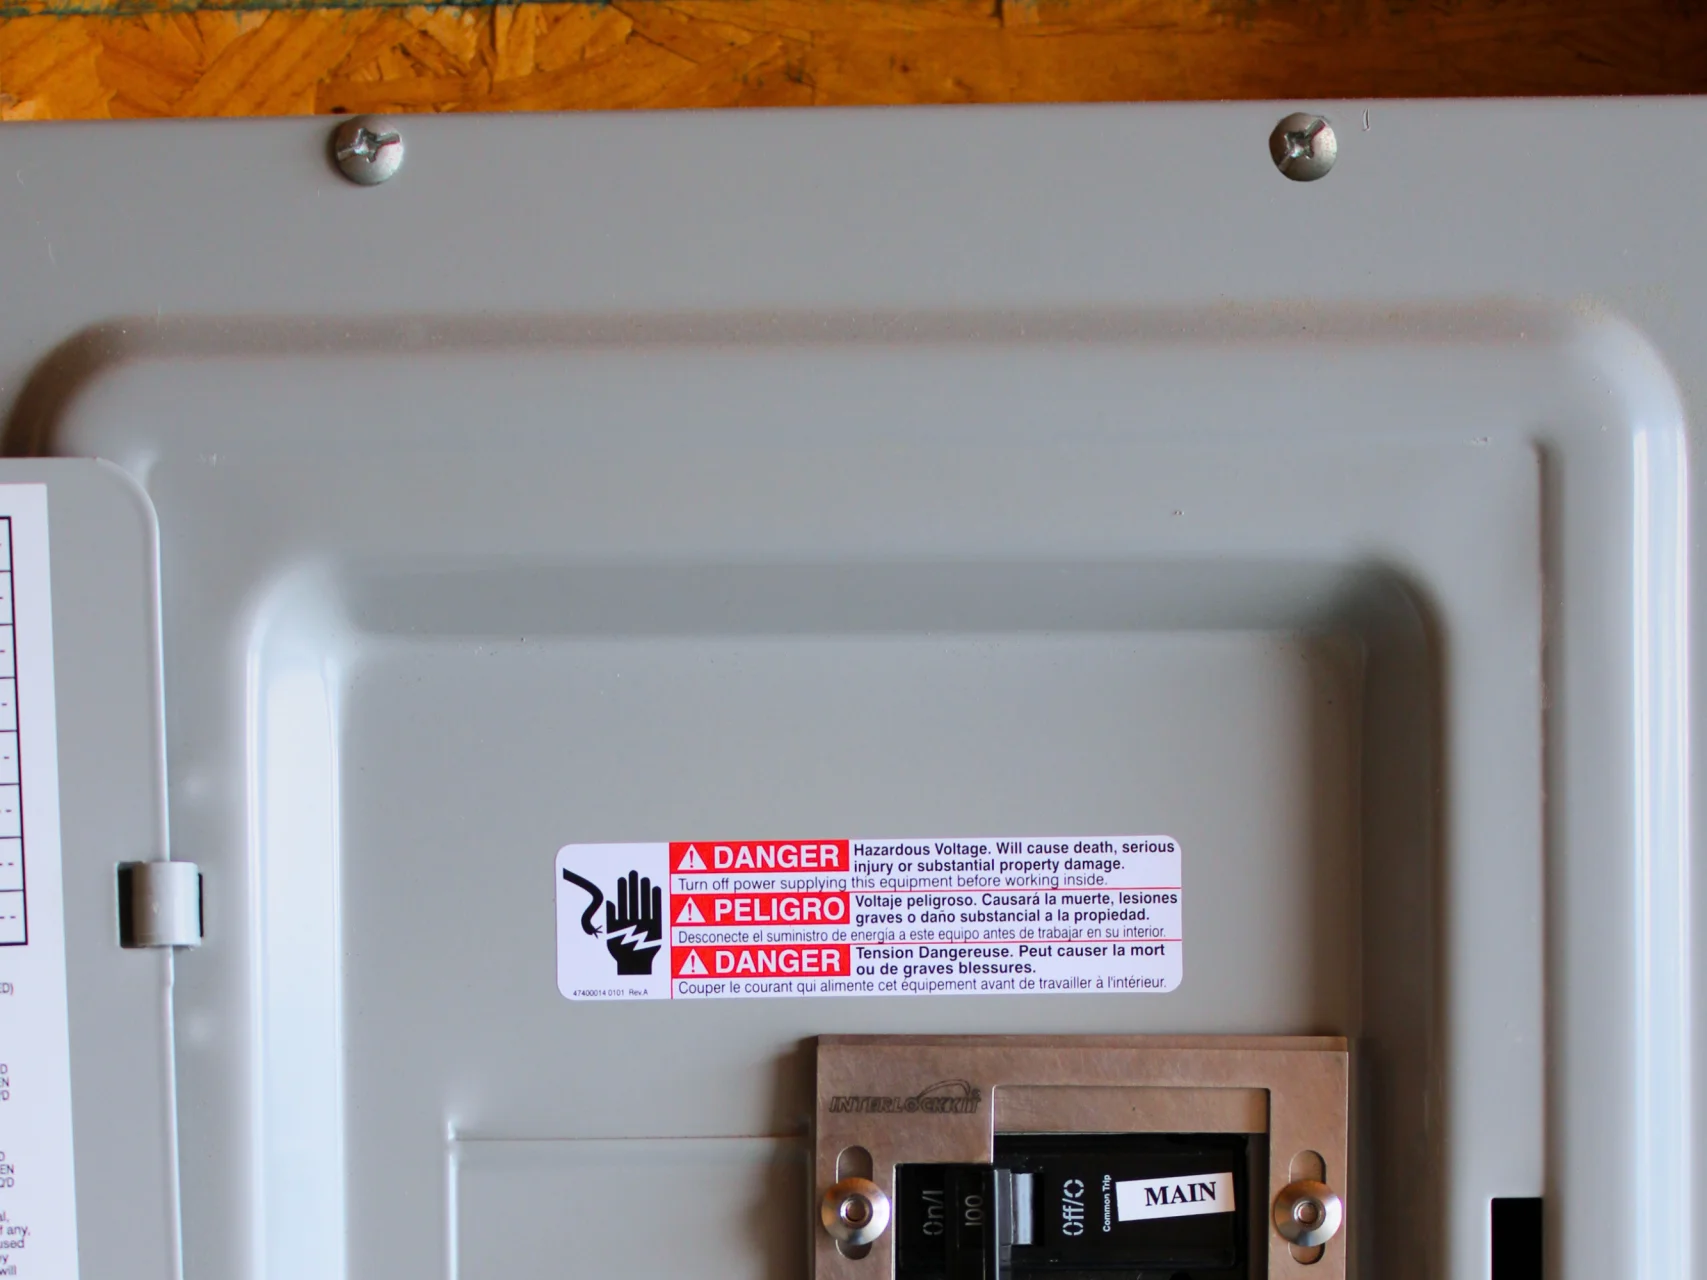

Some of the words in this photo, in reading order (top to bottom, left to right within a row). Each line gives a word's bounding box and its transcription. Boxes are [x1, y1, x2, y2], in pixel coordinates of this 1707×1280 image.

[714, 844, 839, 869] DANGER
[854, 843, 930, 856] Hazardous
[934, 842, 991, 858] Voltage.
[996, 842, 1022, 854] Will
[1027, 844, 1069, 854] cause
[1073, 840, 1117, 854] death,
[1122, 840, 1175, 853] serious
[854, 860, 893, 876] injury
[898, 862, 913, 872] or
[917, 858, 995, 872] substantial
[1000, 858, 1060, 874] property
[1064, 858, 1125, 873] damage.
[678, 878, 708, 891] Turn
[712, 877, 729, 891] off
[733, 880, 776, 892] power
[780, 876, 847, 891] supplying
[851, 874, 875, 888] this
[879, 874, 952, 890] equipment
[957, 874, 1001, 887] before
[1005, 873, 1059, 889] working
[1064, 873, 1107, 886] inside.
[715, 897, 845, 922] PELIGRO
[855, 894, 902, 910] Voltaje
[907, 894, 977, 910] peligroso.
[982, 892, 1040, 906] Causará
[1045, 892, 1057, 905] la
[1061, 893, 1114, 905] muerte,
[1119, 892, 1178, 905] lesiones
[855, 913, 903, 927] graves
[907, 913, 916, 923] o
[920, 910, 956, 923] daño
[960, 909, 1040, 923] substancial
[1045, 911, 1053, 922] a
[1057, 909, 1069, 922] la
[1074, 908, 1150, 924] propiedad.
[678, 930, 749, 944] Desconecte
[752, 930, 763, 943] el
[766, 930, 828, 943] suministro
[831, 929, 847, 942] de
[850, 928, 895, 944] energía
[909, 929, 935, 941] este
[938, 929, 980, 943] equipo
[983, 927, 1016, 940] antes
[1019, 926, 1035, 939] de
[1038, 926, 1083, 942] trabajar
[1086, 928, 1102, 939] en
[1105, 928, 1119, 938] su
[1123, 926, 1167, 939] interior.
[715, 949, 840, 973] DANGER
[855, 946, 913, 959] Tension
[919, 946, 1013, 962] Dangereuse.
[1019, 944, 1052, 957] Peut
[1057, 946, 1108, 957] causer
[1113, 944, 1125, 956] la
[1131, 944, 1165, 956] mort
[856, 965, 875, 976] ou
[880, 962, 898, 975] de
[903, 964, 954, 979] graves
[959, 961, 1036, 974] blessures.
[678, 981, 726, 997] Couper
[729, 981, 741, 994] le
[744, 981, 793, 994] courant
[796, 982, 816, 995] qui
[820, 979, 874, 992] alimente
[878, 979, 897, 991] cet
[901, 978, 977, 994] équipement
[981, 978, 1015, 990] avant
[1019, 977, 1035, 990] de
[1039, 976, 1092, 990] travailler
[1108, 976, 1167, 989] l'intérieur.
[1103, 1174, 1112, 1192] Trip
[1144, 1181, 1217, 1207] MAIN
[1103, 1193, 1111, 1232] Common
